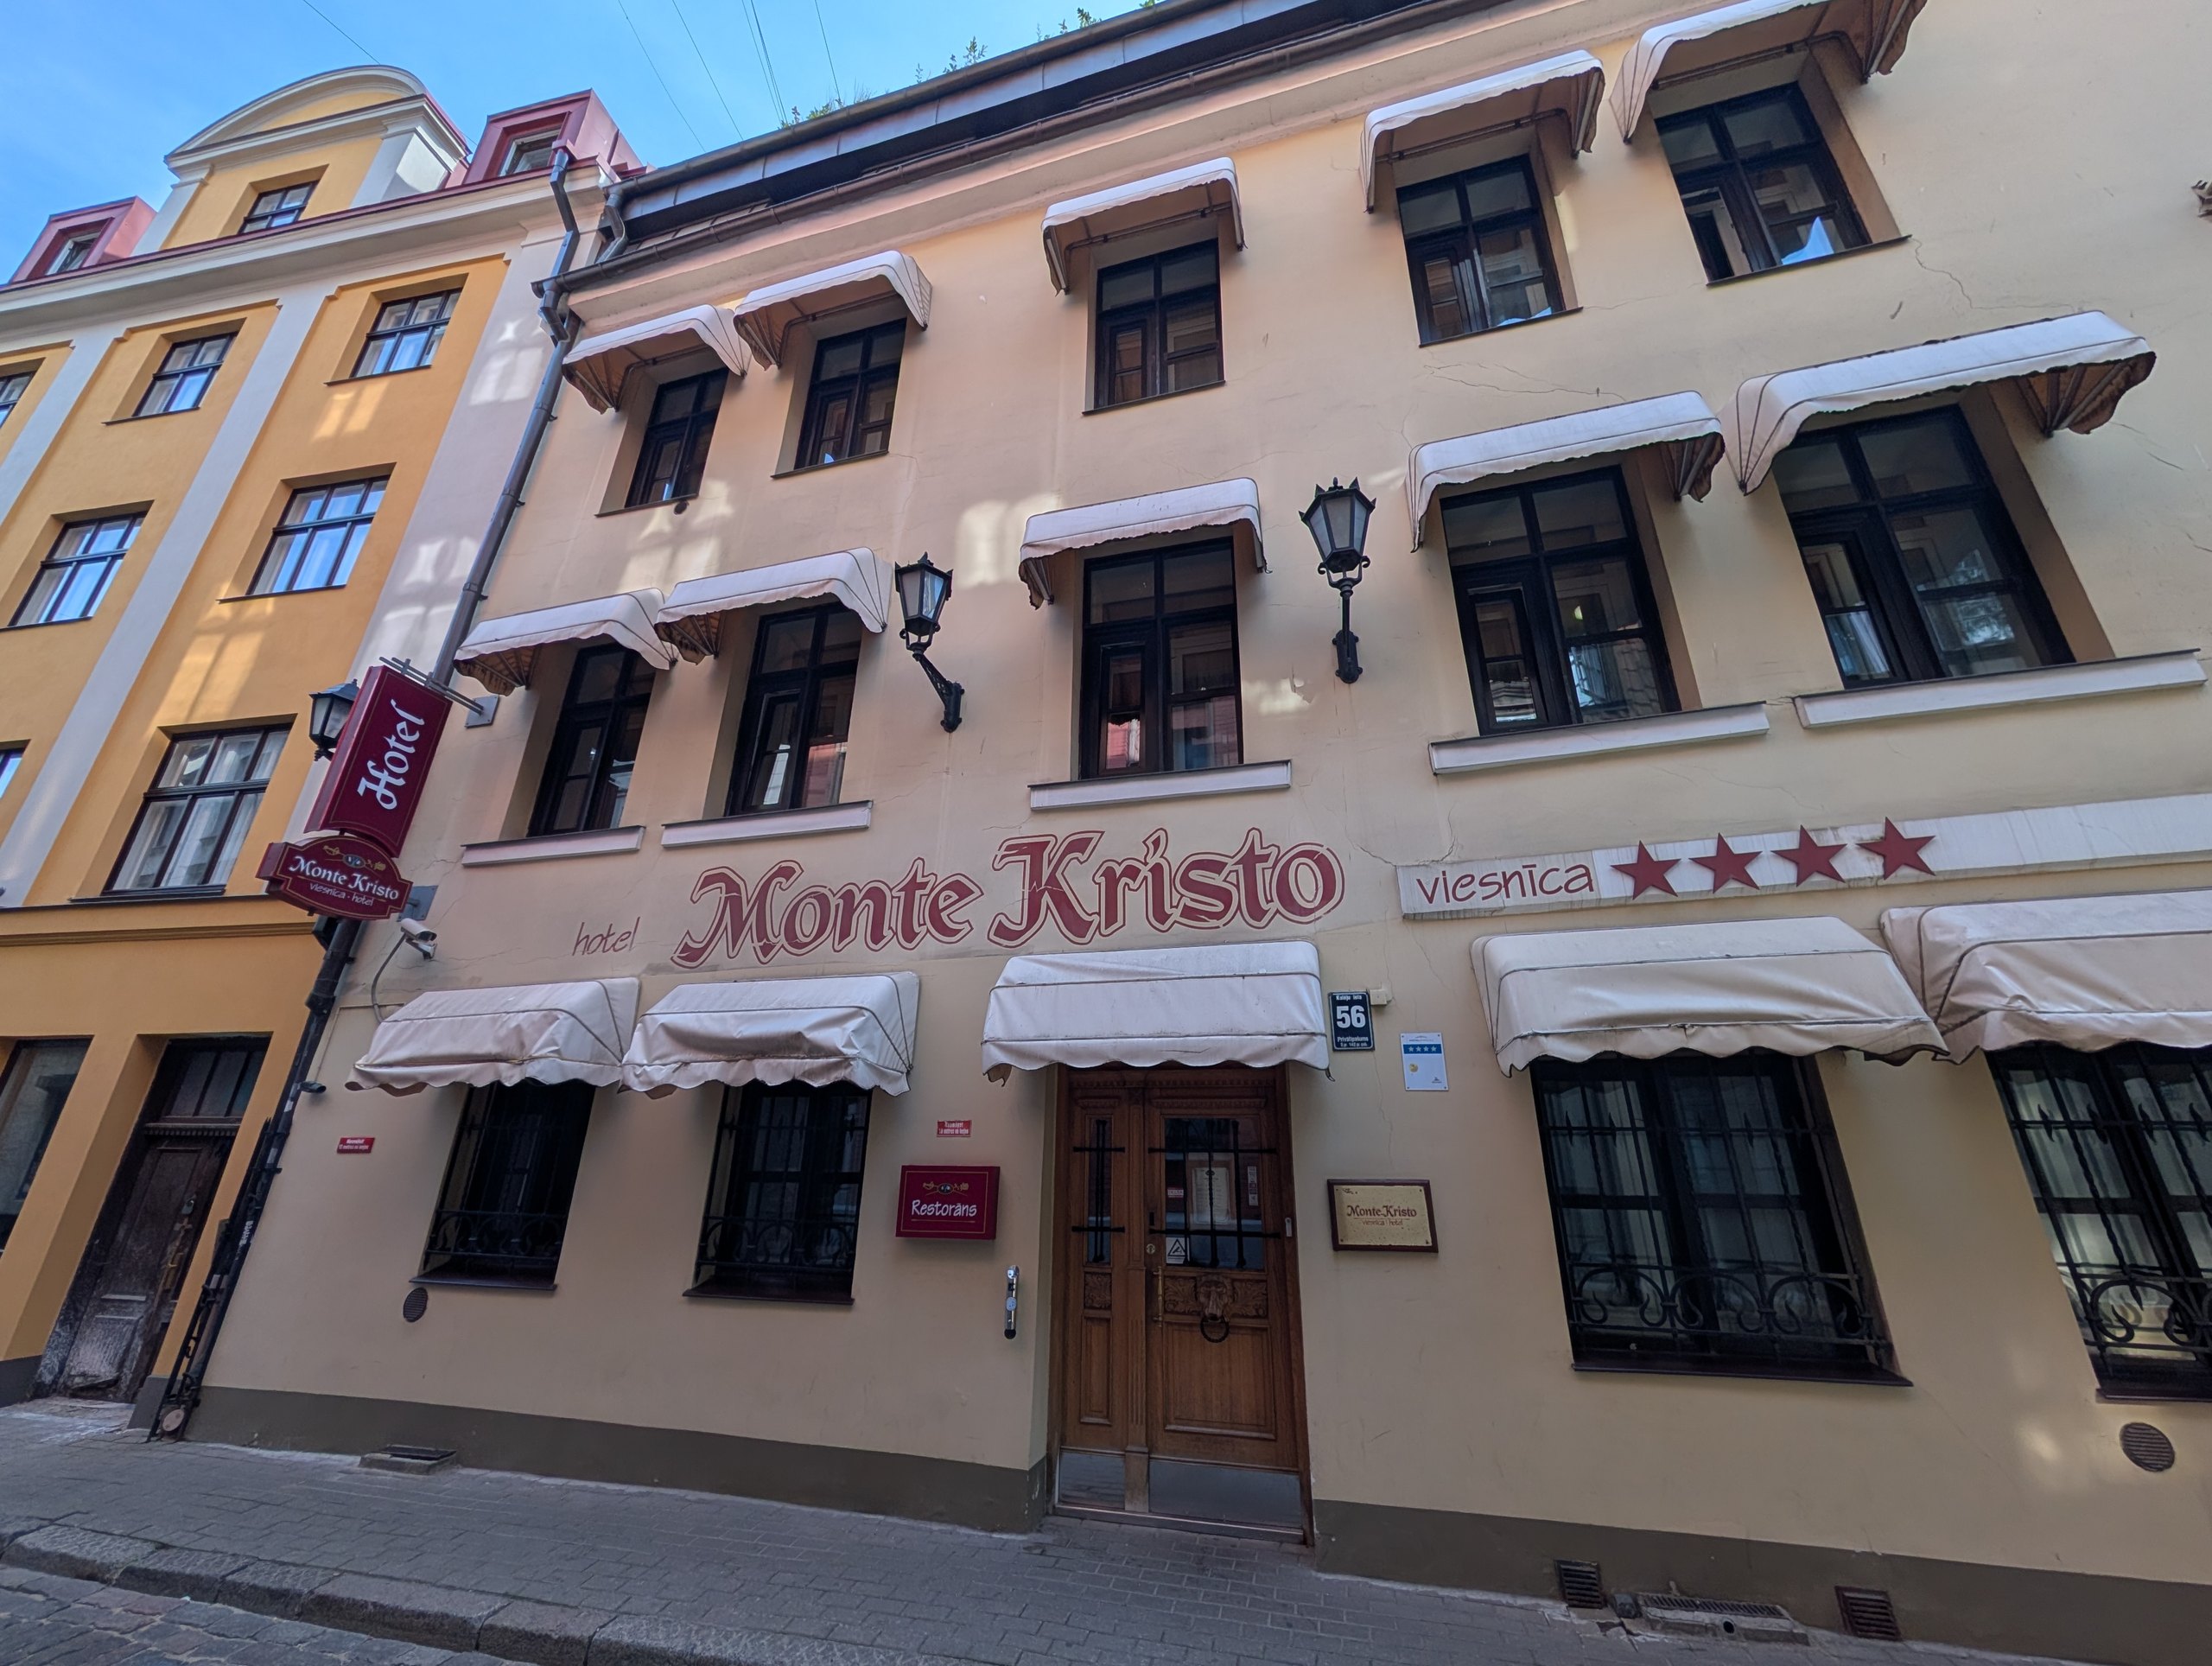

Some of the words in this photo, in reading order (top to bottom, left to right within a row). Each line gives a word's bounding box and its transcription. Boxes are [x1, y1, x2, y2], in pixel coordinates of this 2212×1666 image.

[357, 699, 425, 811] Hotel
[289, 855, 347, 885] Monte
[347, 873, 399, 900] Kristo
[1416, 863, 1594, 905] viesnīca
[352, 893, 374, 906] hotel
[670, 858, 985, 969] Monte
[987, 827, 1345, 948] Kristo
[572, 916, 640, 956] hotel
[1336, 1005, 1366, 1028] 56
[912, 1199, 977, 1217] Restorāns
[1346, 1205, 1382, 1217] Monte
[1382, 1205, 1417, 1217] Kristo
